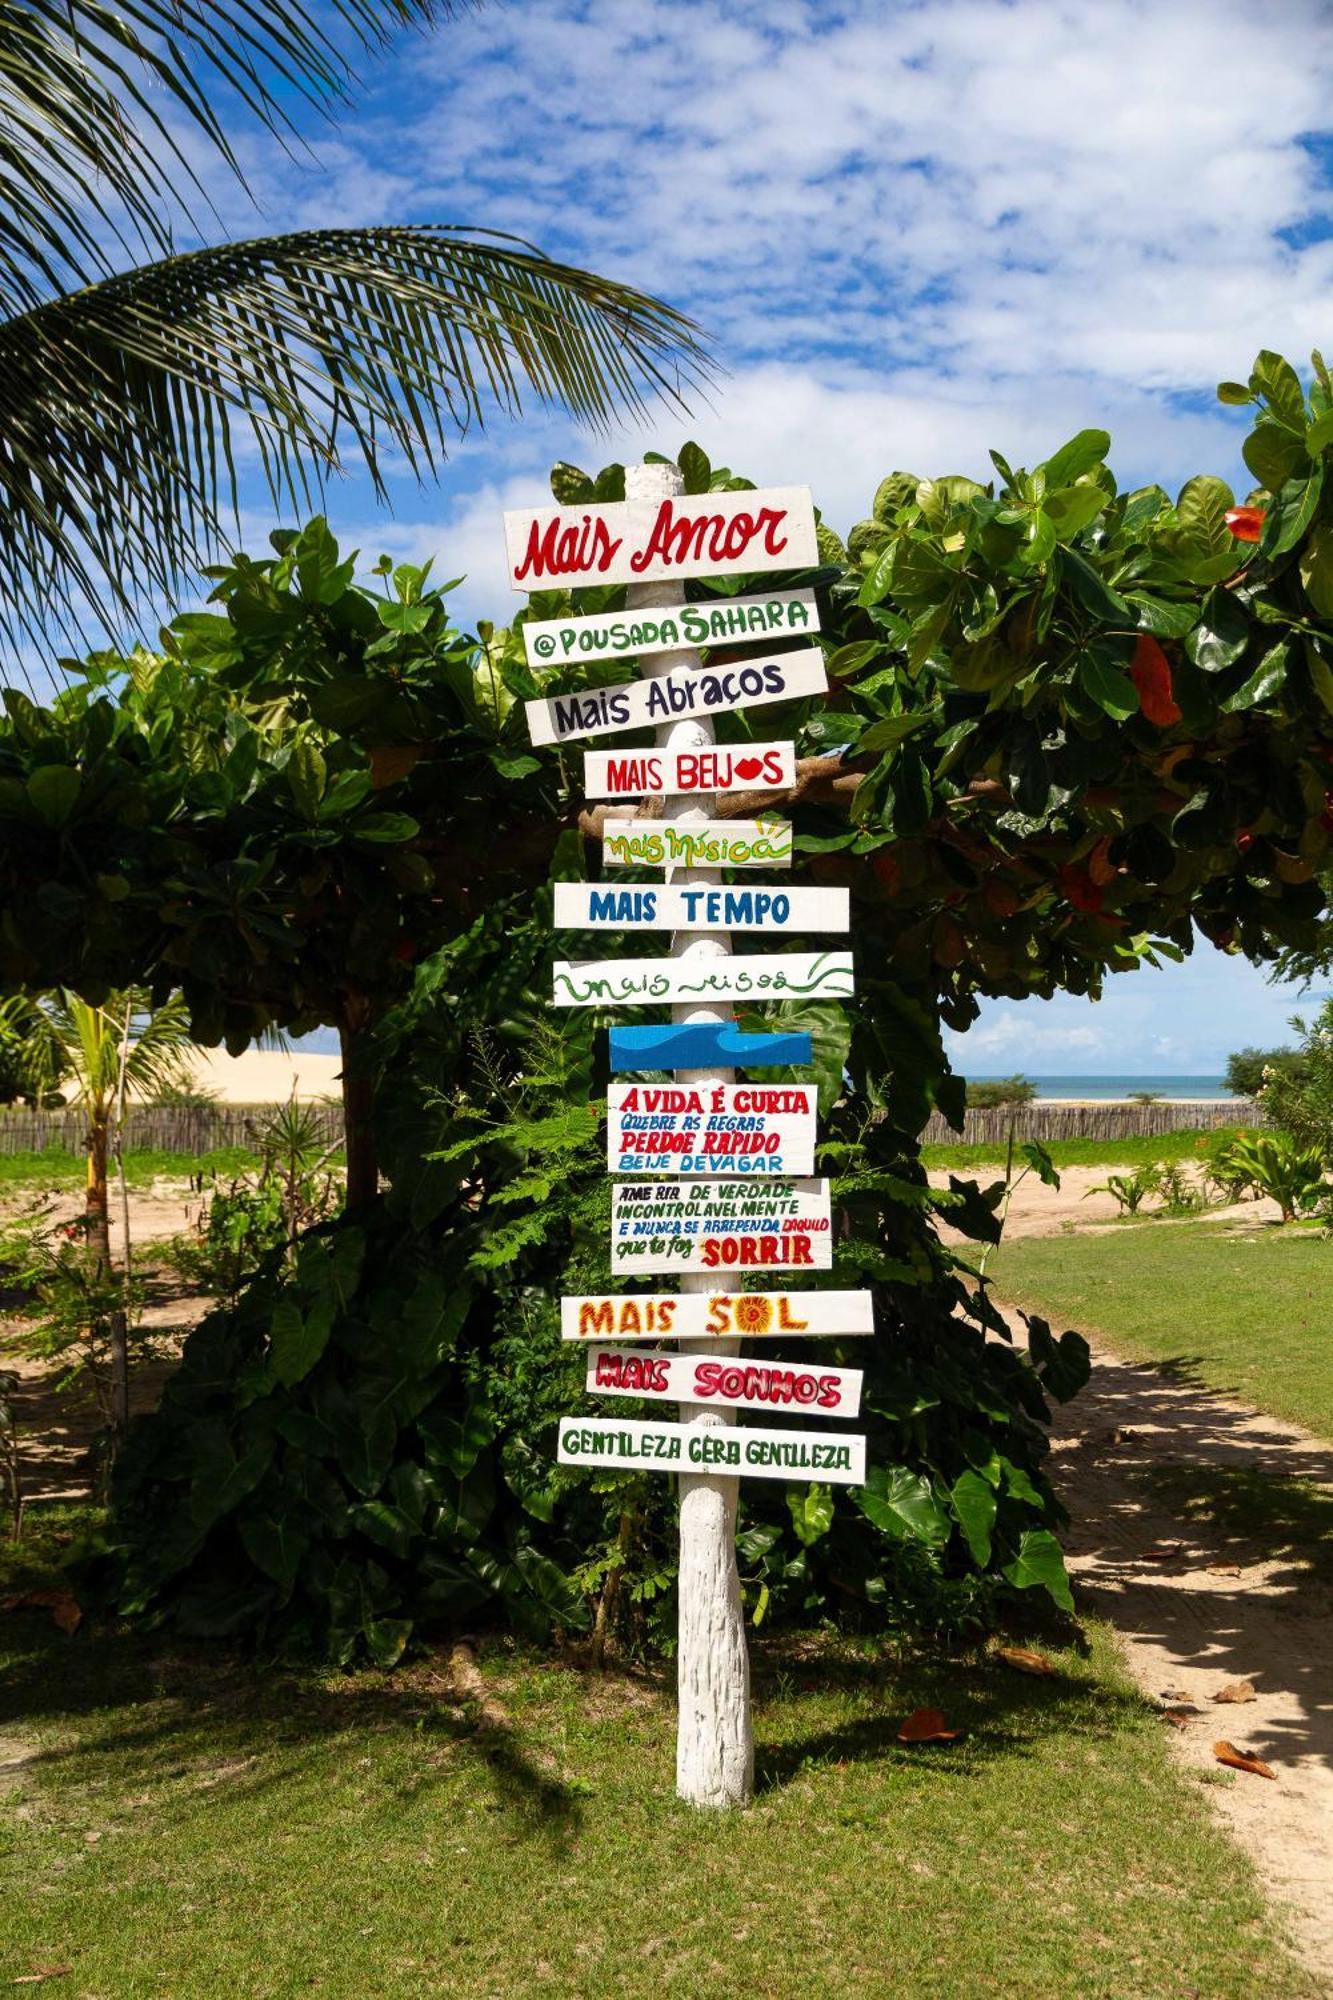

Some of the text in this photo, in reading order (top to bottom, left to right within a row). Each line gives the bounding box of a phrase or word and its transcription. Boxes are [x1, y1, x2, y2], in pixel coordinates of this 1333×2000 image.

[514, 499, 788, 581] Mais Amor
[555, 665, 786, 733] Mais Abraços
[607, 758, 663, 792] MAIS
[589, 891, 790, 925] MAIS TEMPO
[562, 974, 670, 1001] mais
[619, 1086, 809, 1114] A VIDA É CURTA
[621, 1113, 765, 1131] QUEBRE AS REGRAS
[619, 1132, 696, 1154] PERDOE
[619, 1155, 783, 1172] BEIJE DEVAGAR
[619, 1186, 652, 1201] AME
[689, 1185, 711, 1200] DE
[718, 1183, 797, 1200] VERDADE
[619, 1222, 630, 1235] E
[633, 1221, 681, 1236] NUNCA
[684, 1221, 699, 1233] SE
[703, 1218, 780, 1234] ARREPENDA
[616, 1240, 647, 1260] que
[649, 1236, 666, 1255] te
[701, 1234, 814, 1267] SORRIR
[579, 1296, 808, 1336] MAIS SOL
[595, 1353, 671, 1392] MAIS
[562, 1429, 681, 1459] GENTILEZA
[745, 1440, 852, 1470] GENTILEZA
